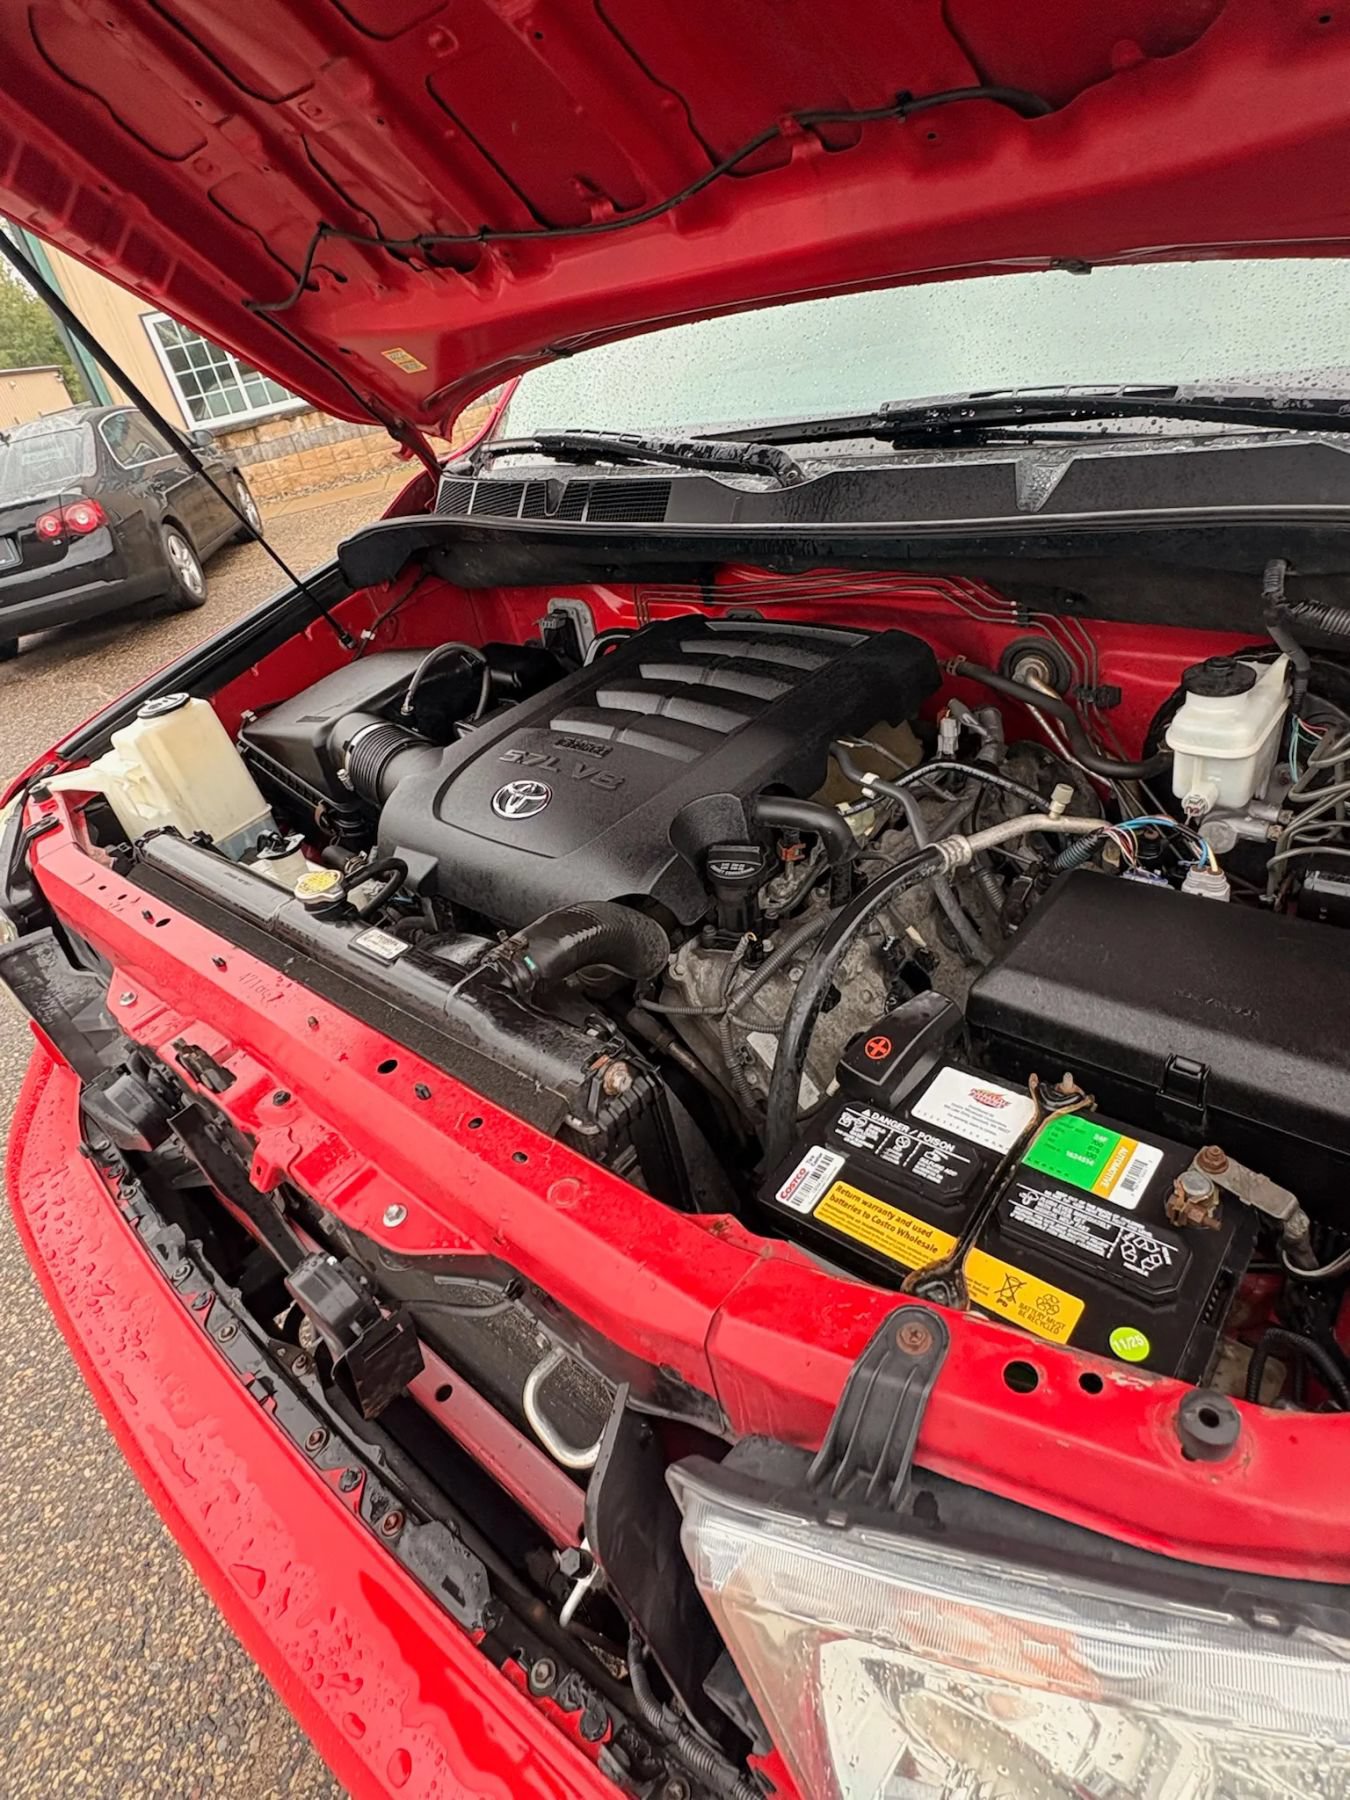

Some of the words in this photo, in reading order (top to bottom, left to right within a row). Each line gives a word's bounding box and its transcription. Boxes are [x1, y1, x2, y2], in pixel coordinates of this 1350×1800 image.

[871, 1112, 911, 1134] DANGER
[917, 1131, 956, 1152] POISON
[779, 1167, 807, 1200] COSTCO
[828, 1193, 863, 1216] batteries
[861, 1210, 872, 1220] to
[870, 1215, 897, 1233] Costco
[895, 1227, 939, 1254] Wholesale
[835, 1184, 862, 1203] Return
[860, 1198, 896, 1222] warranty
[894, 1215, 912, 1229] and
[911, 1223, 933, 1239] used
[1017, 1309, 1027, 1318] BE
[1026, 1312, 1060, 1335] RECYCLED
[1018, 1302, 1045, 1321] BATTERY
[1046, 1316, 1066, 1330] MUST
[1113, 1335, 1144, 1351] 11/25
